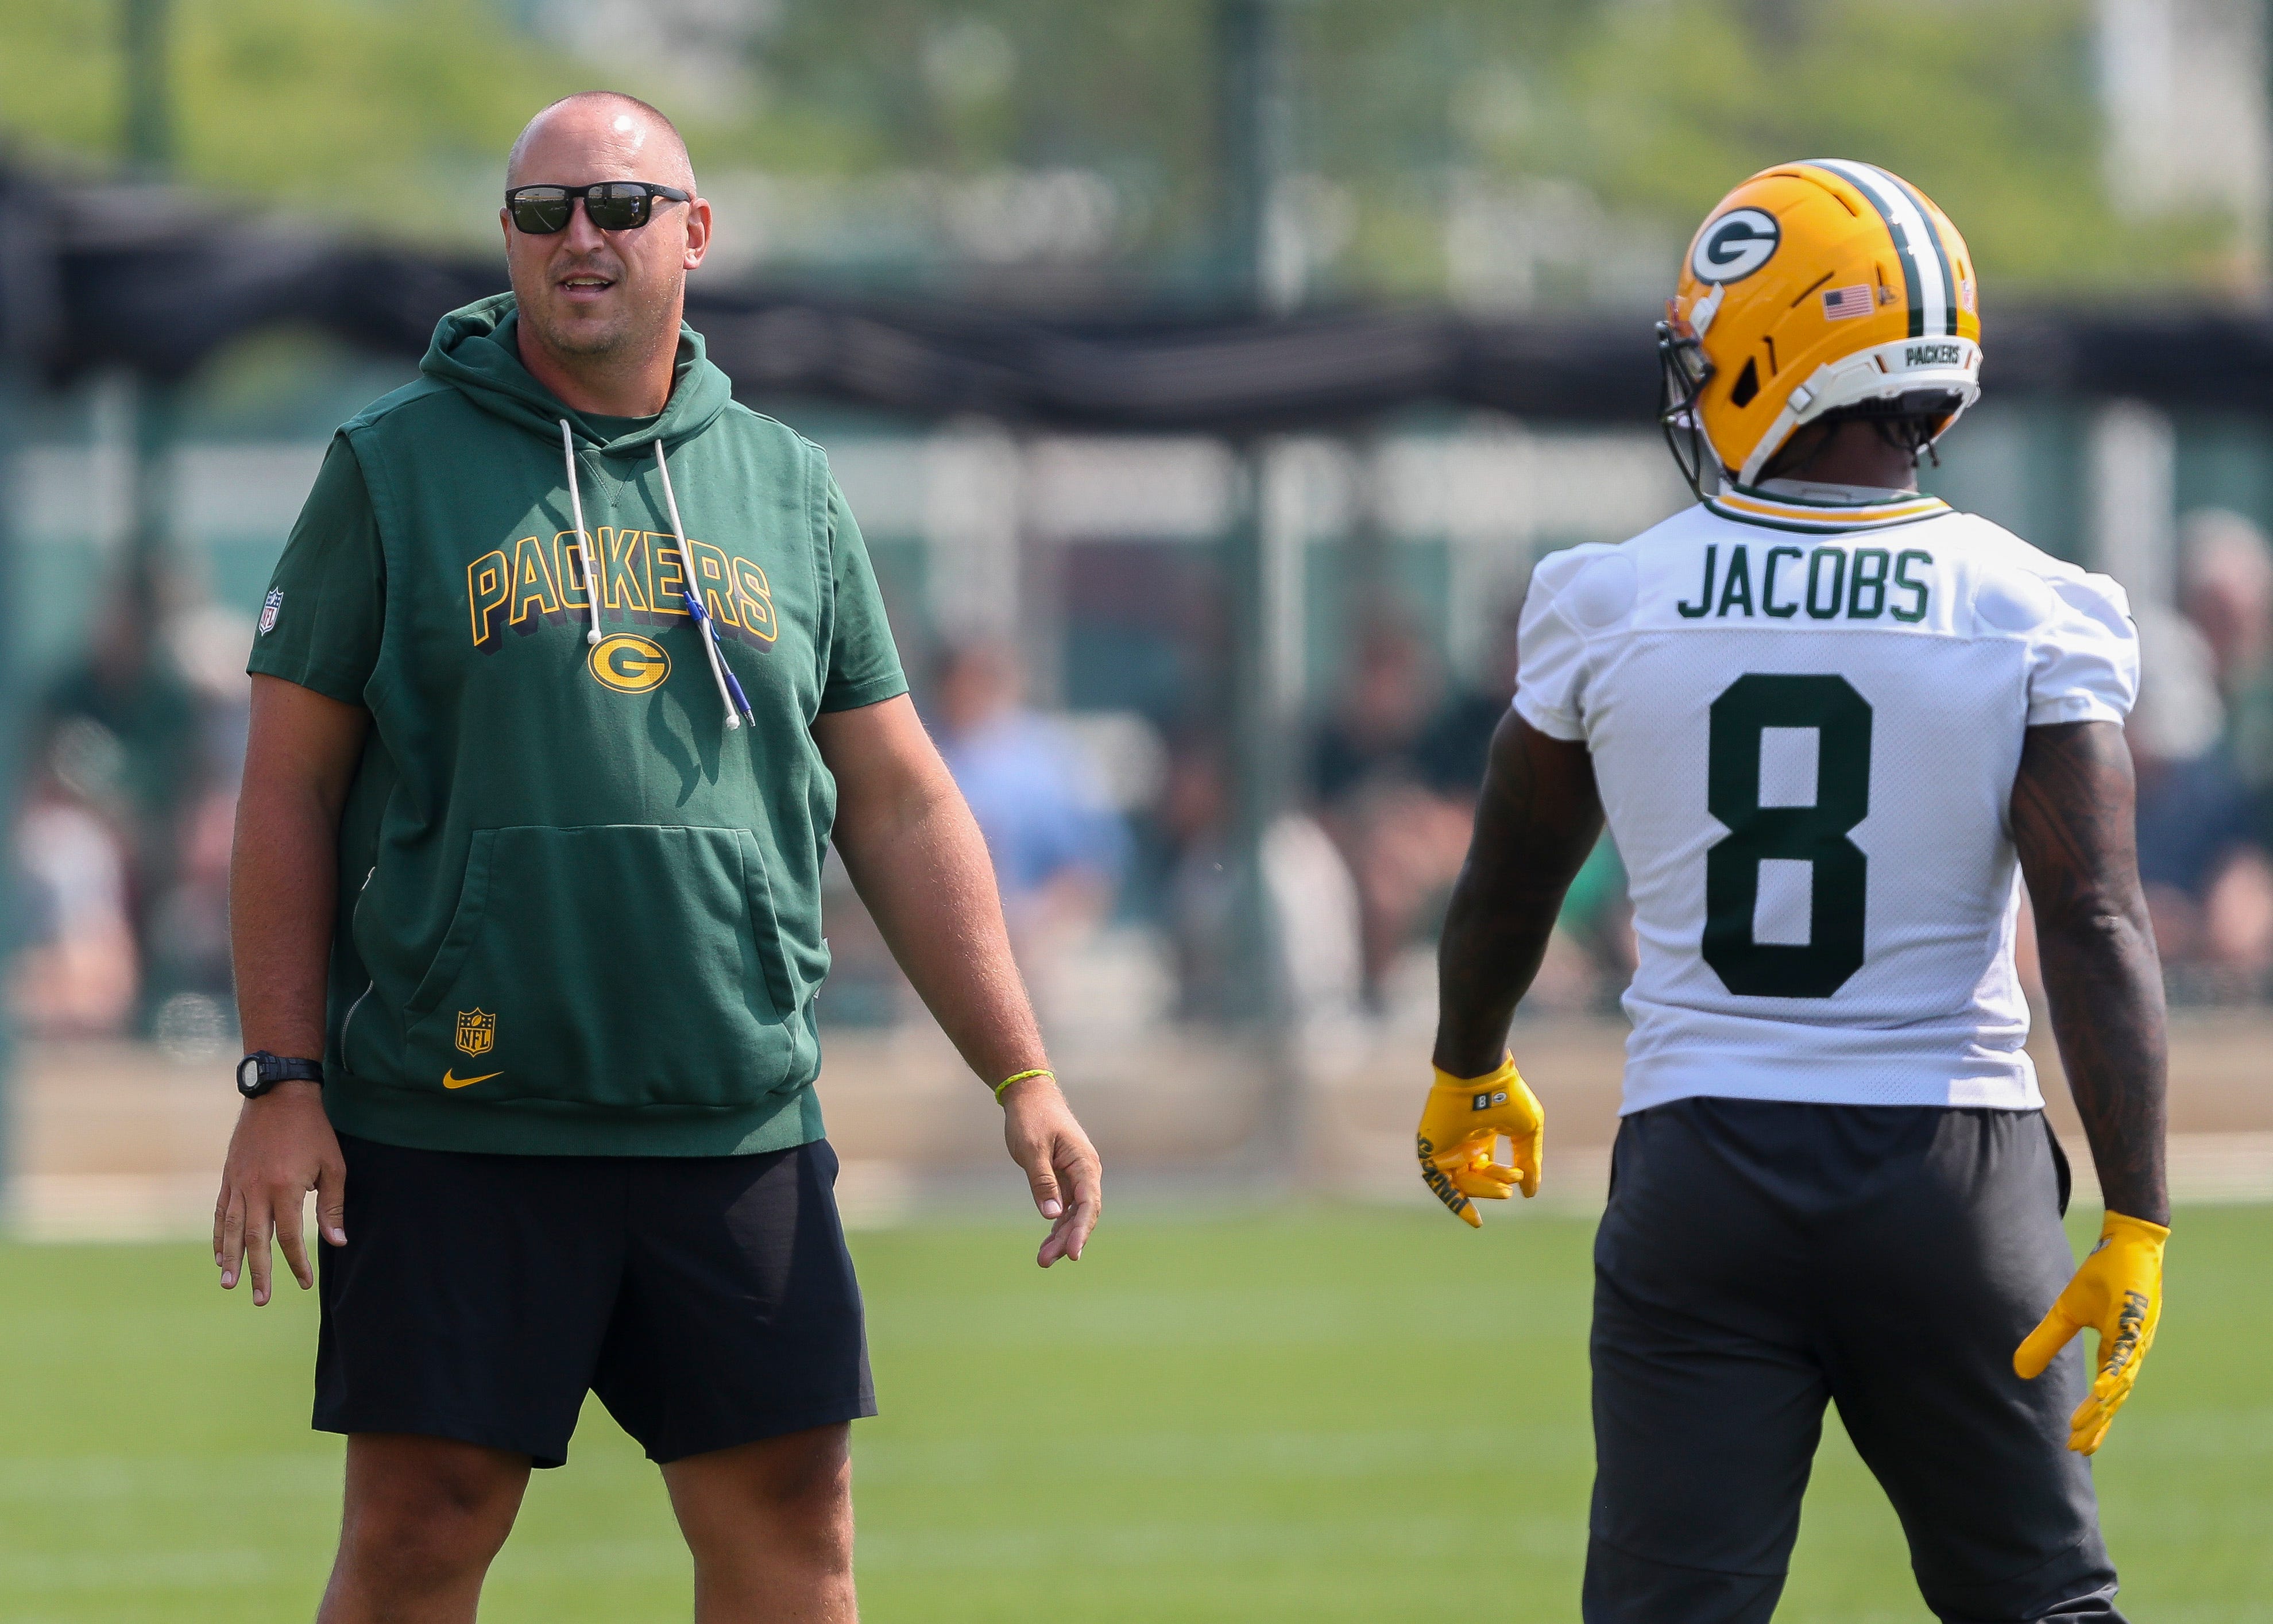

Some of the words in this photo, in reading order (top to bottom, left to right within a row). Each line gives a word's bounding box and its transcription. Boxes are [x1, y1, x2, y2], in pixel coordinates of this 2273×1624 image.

[1692, 207, 1779, 283] G
[1906, 345, 1960, 366] PACKERS
[466, 526, 778, 647] PACKERS
[1678, 544, 1933, 622] JACOBS
[594, 638, 666, 686] G
[1702, 673, 1872, 998] 8
[460, 1029, 488, 1050] NFL
